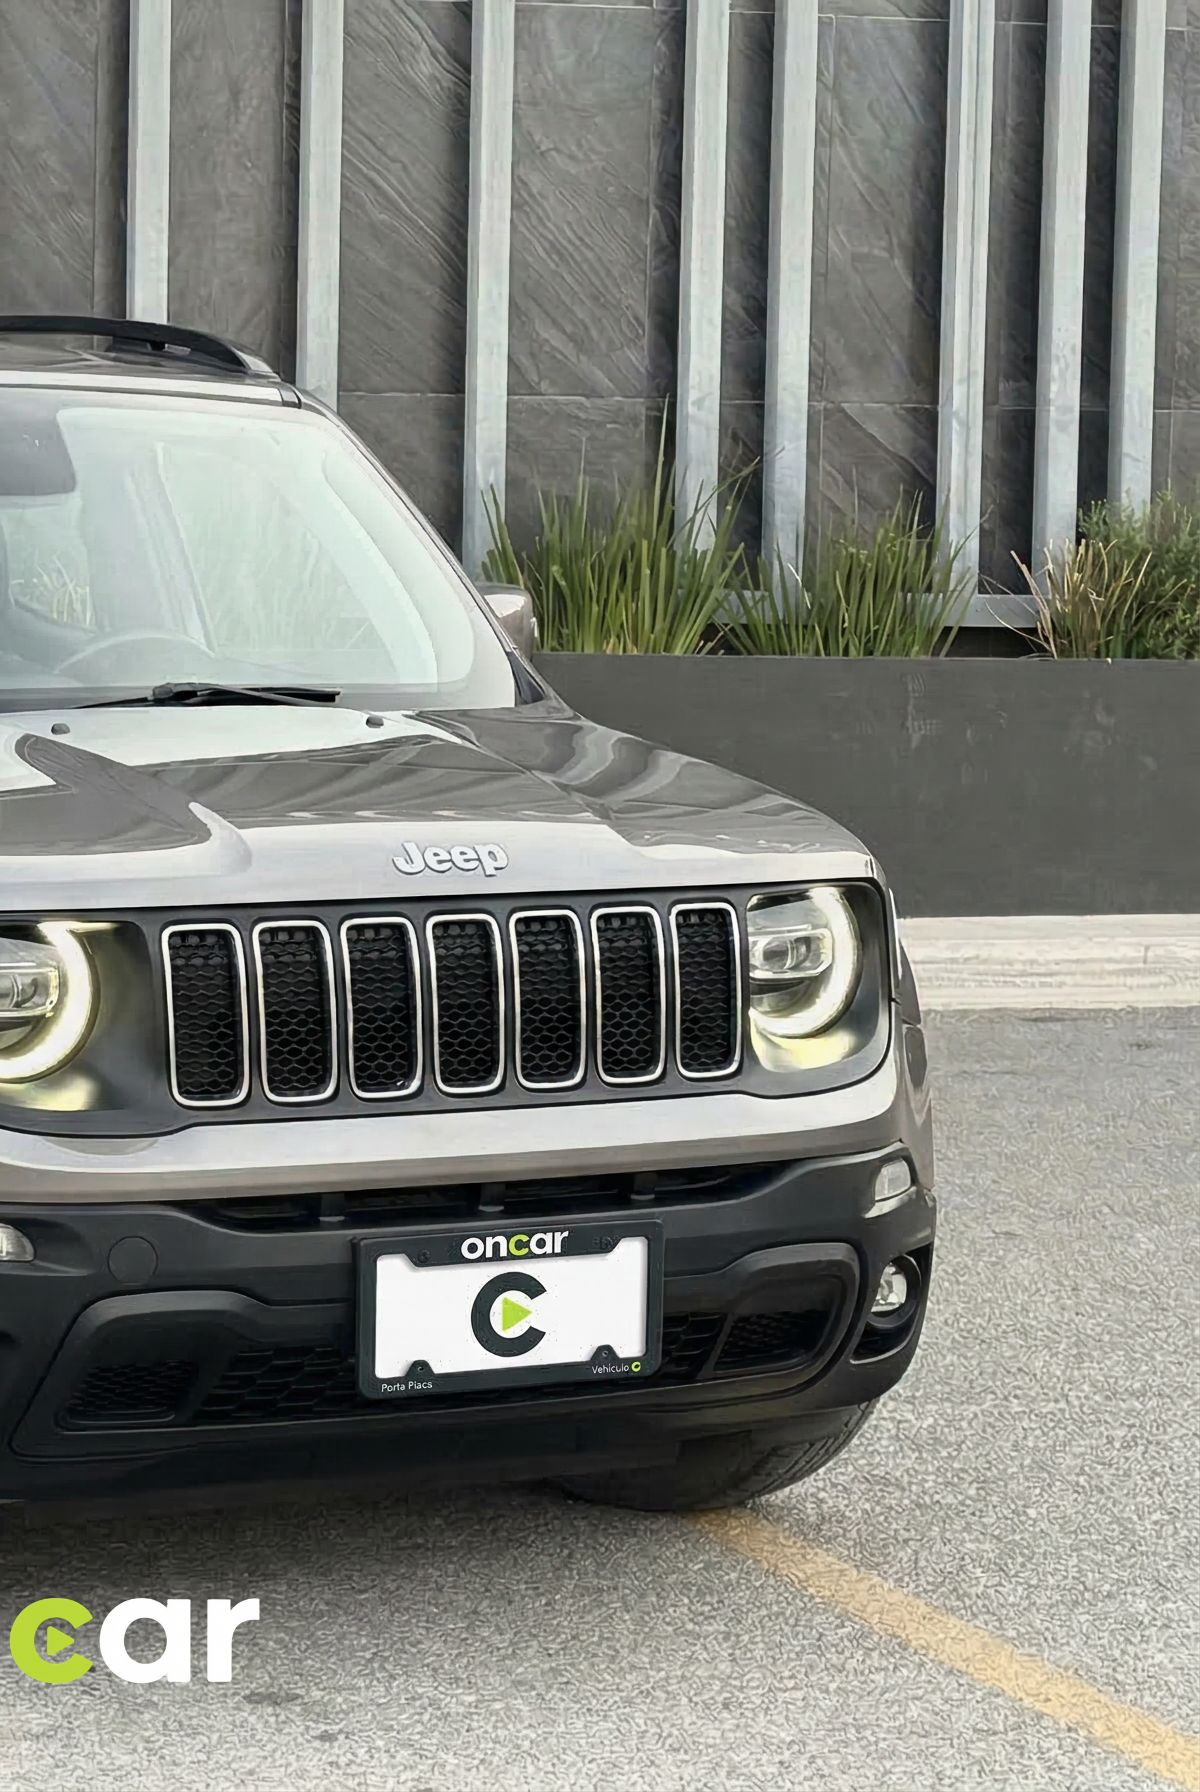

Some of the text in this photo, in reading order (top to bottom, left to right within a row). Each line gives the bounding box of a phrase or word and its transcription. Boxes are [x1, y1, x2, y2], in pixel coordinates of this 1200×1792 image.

[392, 841, 509, 877] Jeep
[460, 1230, 569, 1260] oncar
[381, 1382, 406, 1392] Porta
